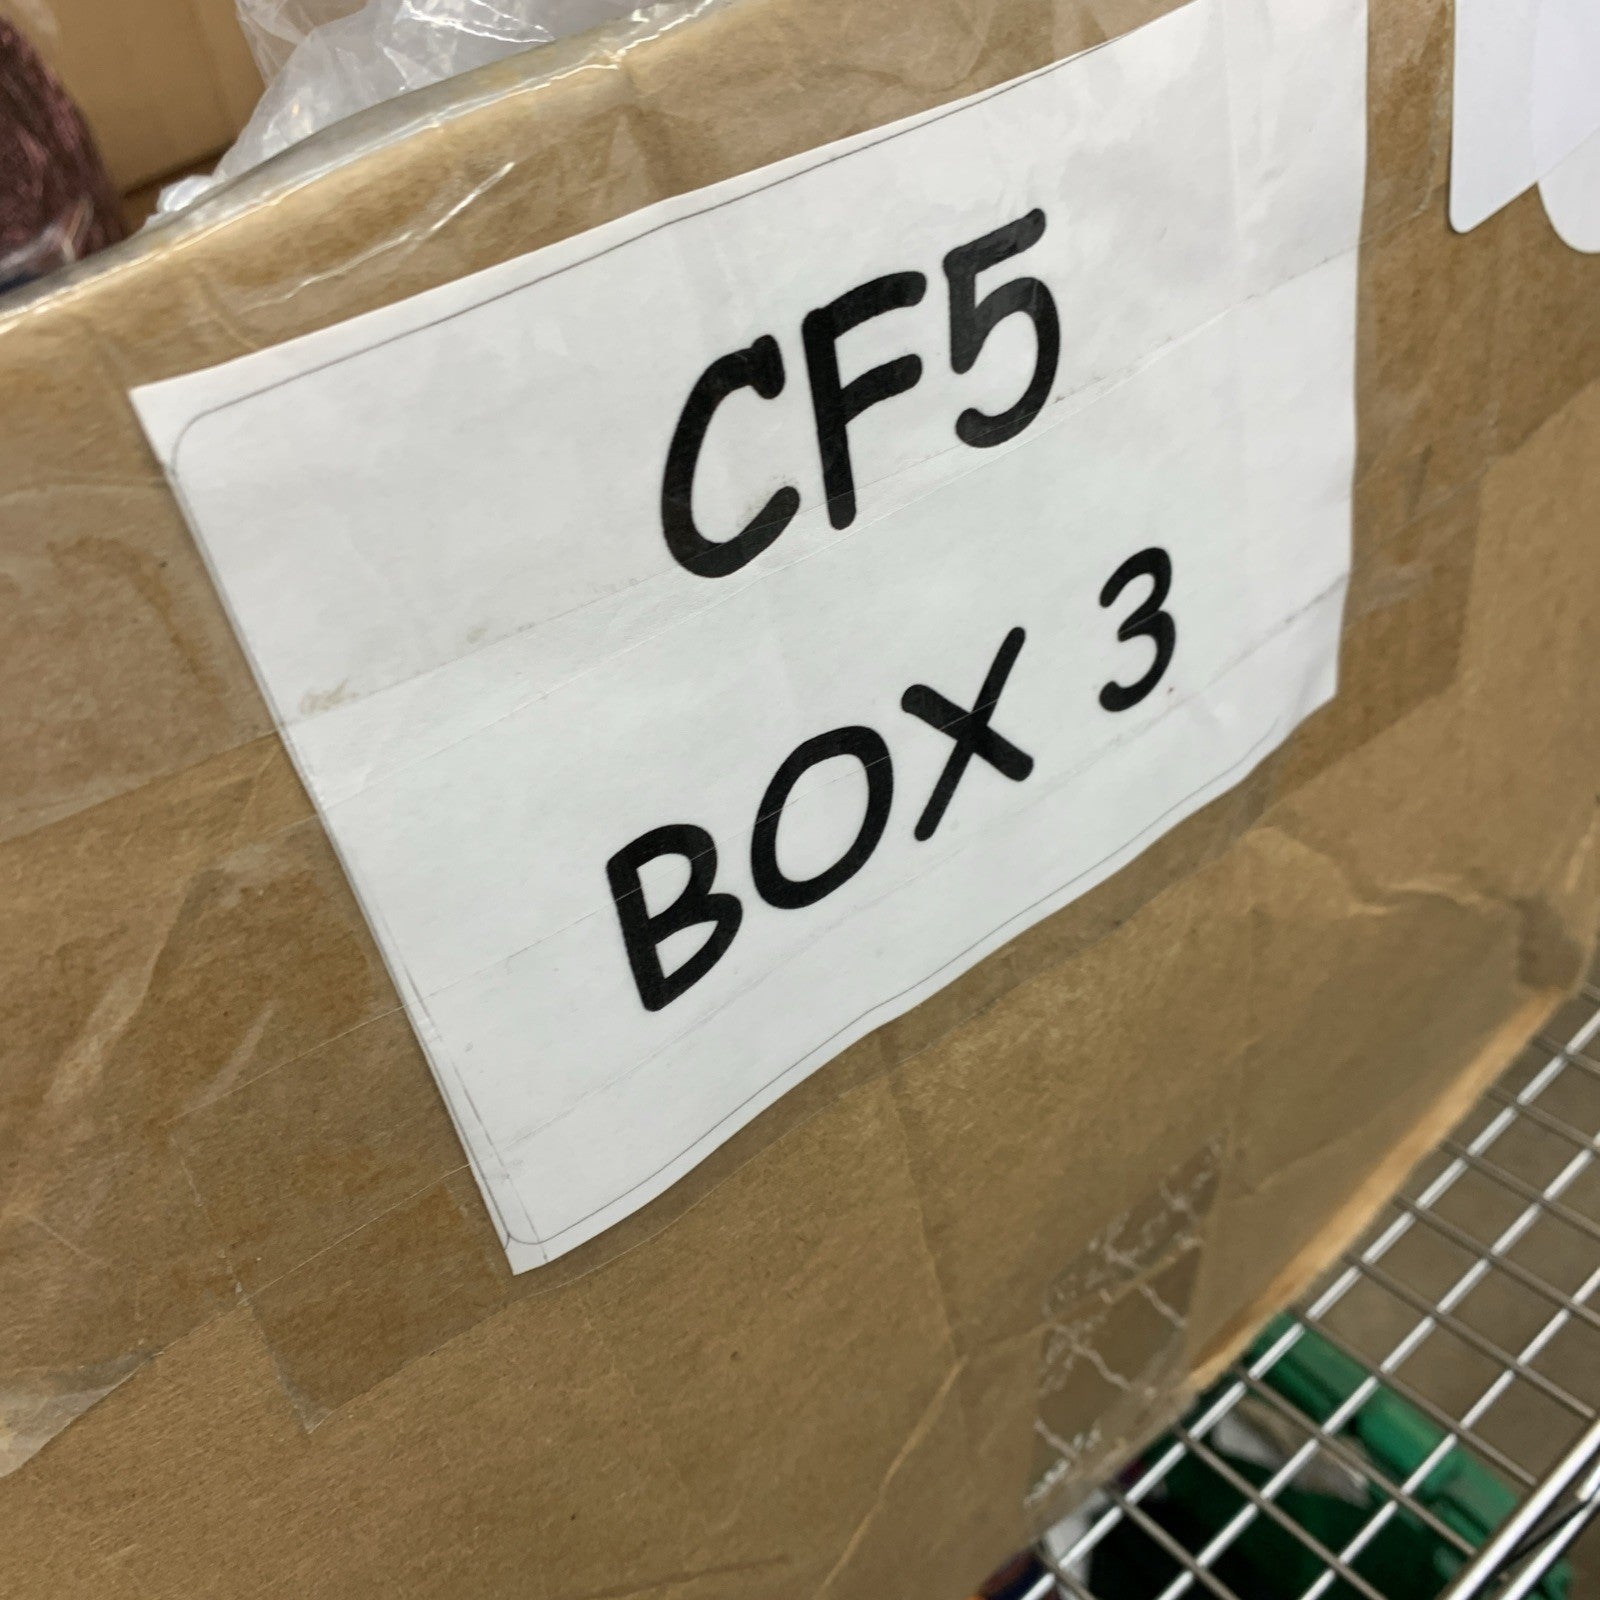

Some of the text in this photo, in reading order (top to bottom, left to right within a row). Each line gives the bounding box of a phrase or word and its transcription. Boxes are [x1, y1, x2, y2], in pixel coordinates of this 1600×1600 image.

[660, 207, 1062, 579] CF5
[605, 546, 1177, 1013] BOX 3
